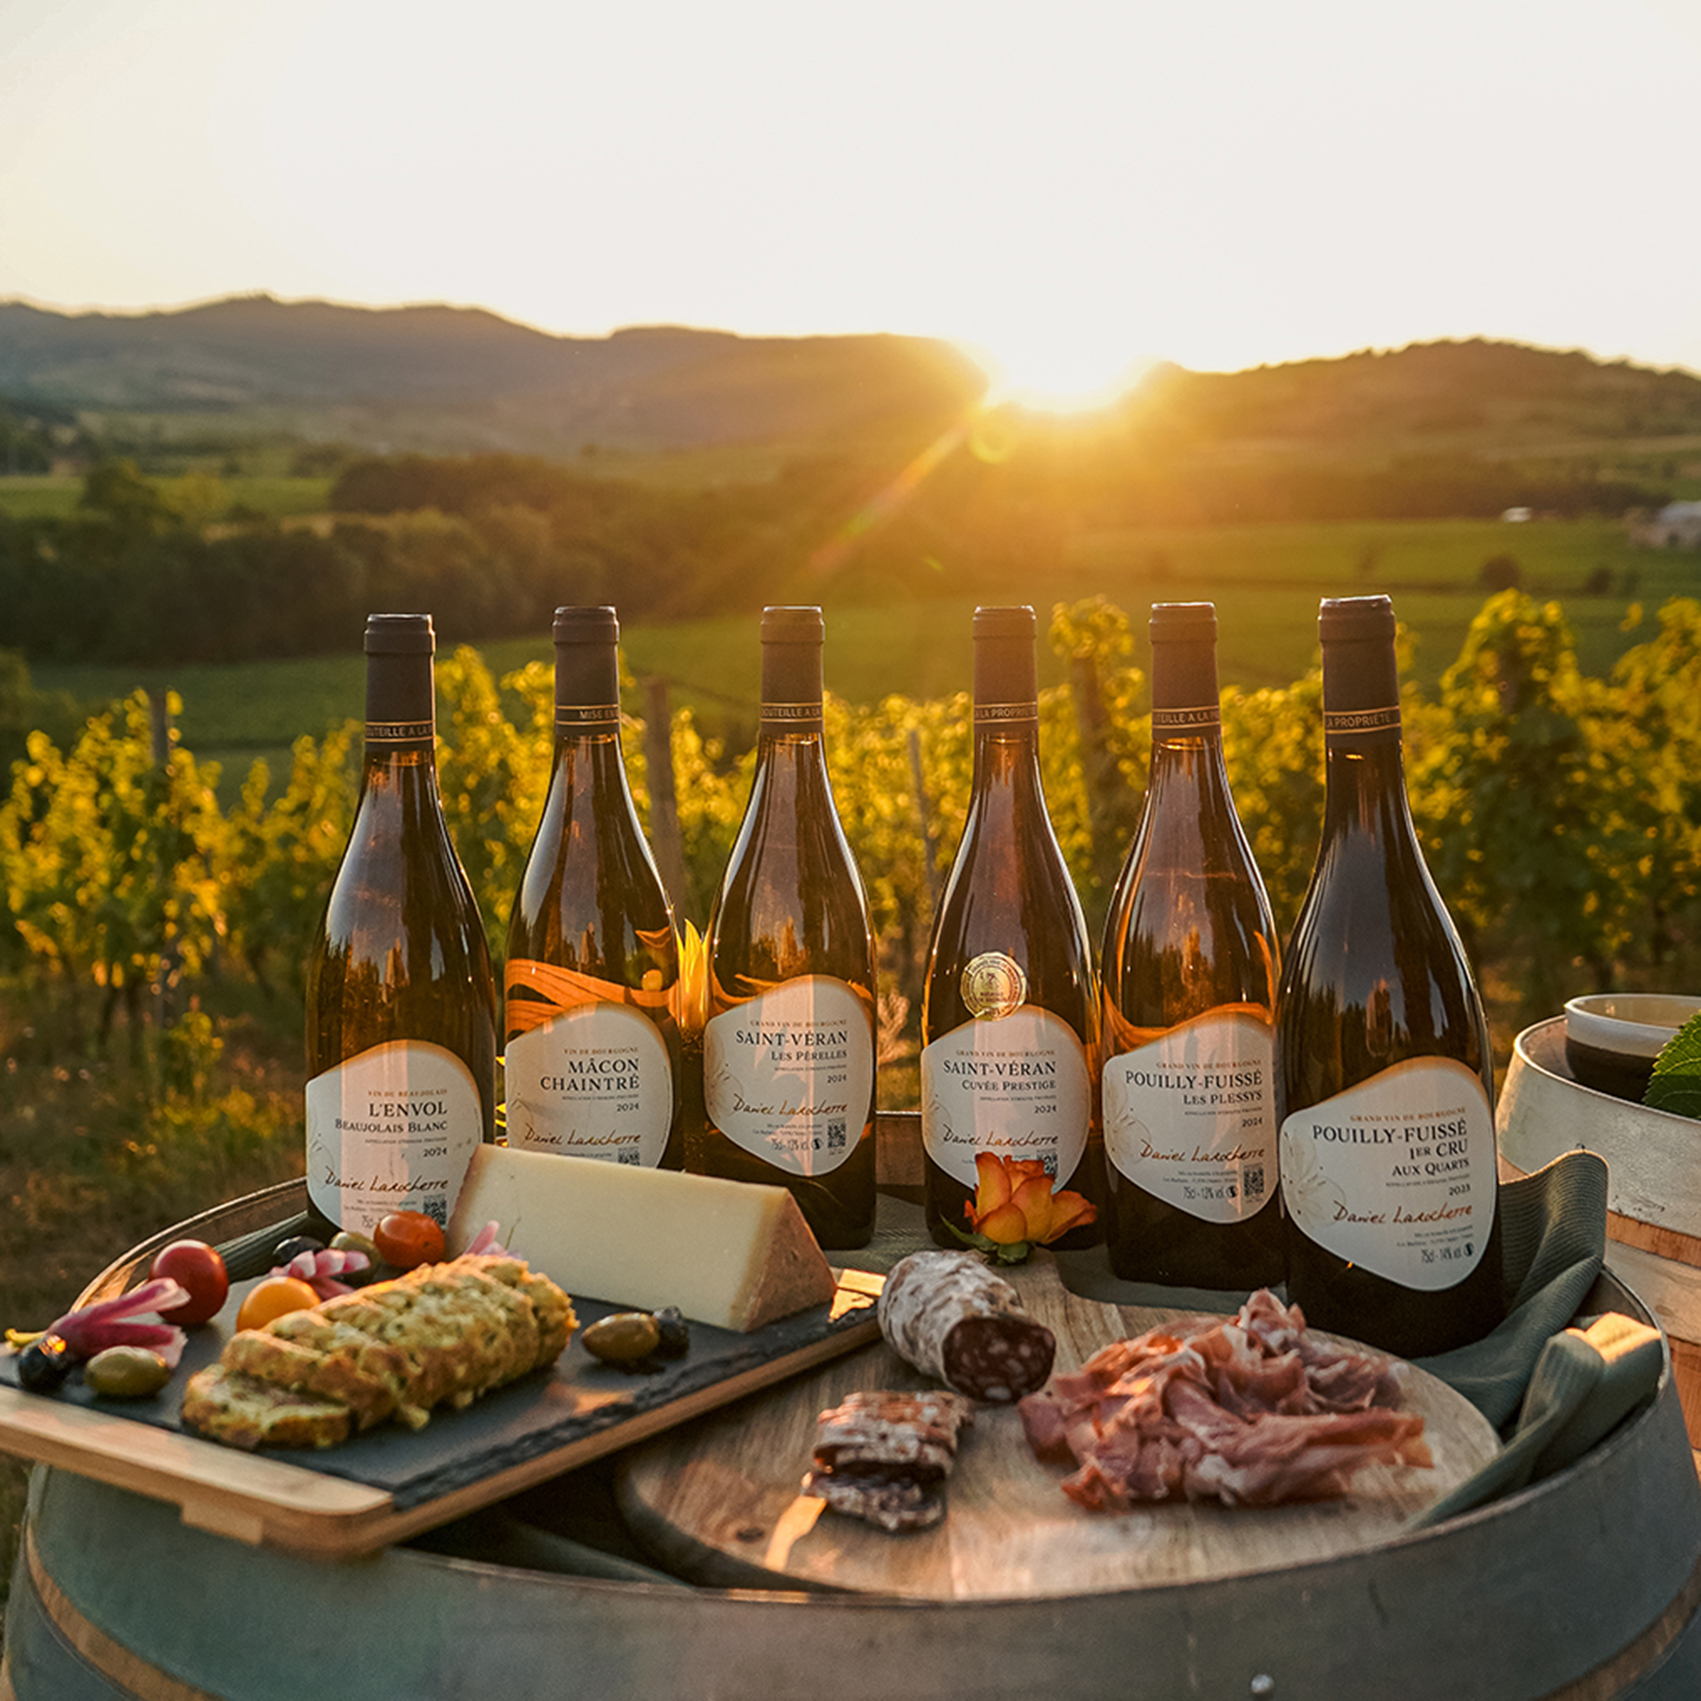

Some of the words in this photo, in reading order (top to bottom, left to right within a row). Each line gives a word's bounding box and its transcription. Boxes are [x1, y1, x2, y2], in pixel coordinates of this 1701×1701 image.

[735, 1029, 848, 1046] SAINT-VÉRAN
[567, 1057, 639, 1074] MÂCON
[943, 1059, 1057, 1076] SAINT-VÉRAN
[540, 1073, 640, 1091] CHAINTRÉ
[1125, 1069, 1263, 1089] POUILLY-FUISSÉ
[369, 1100, 448, 1118] L'ENVOL
[616, 1102, 640, 1112] 2024
[1034, 1104, 1057, 1114] 2024
[1312, 1118, 1468, 1144] POUILLY-FUISSÉ
[1435, 1138, 1469, 1157] CRU
